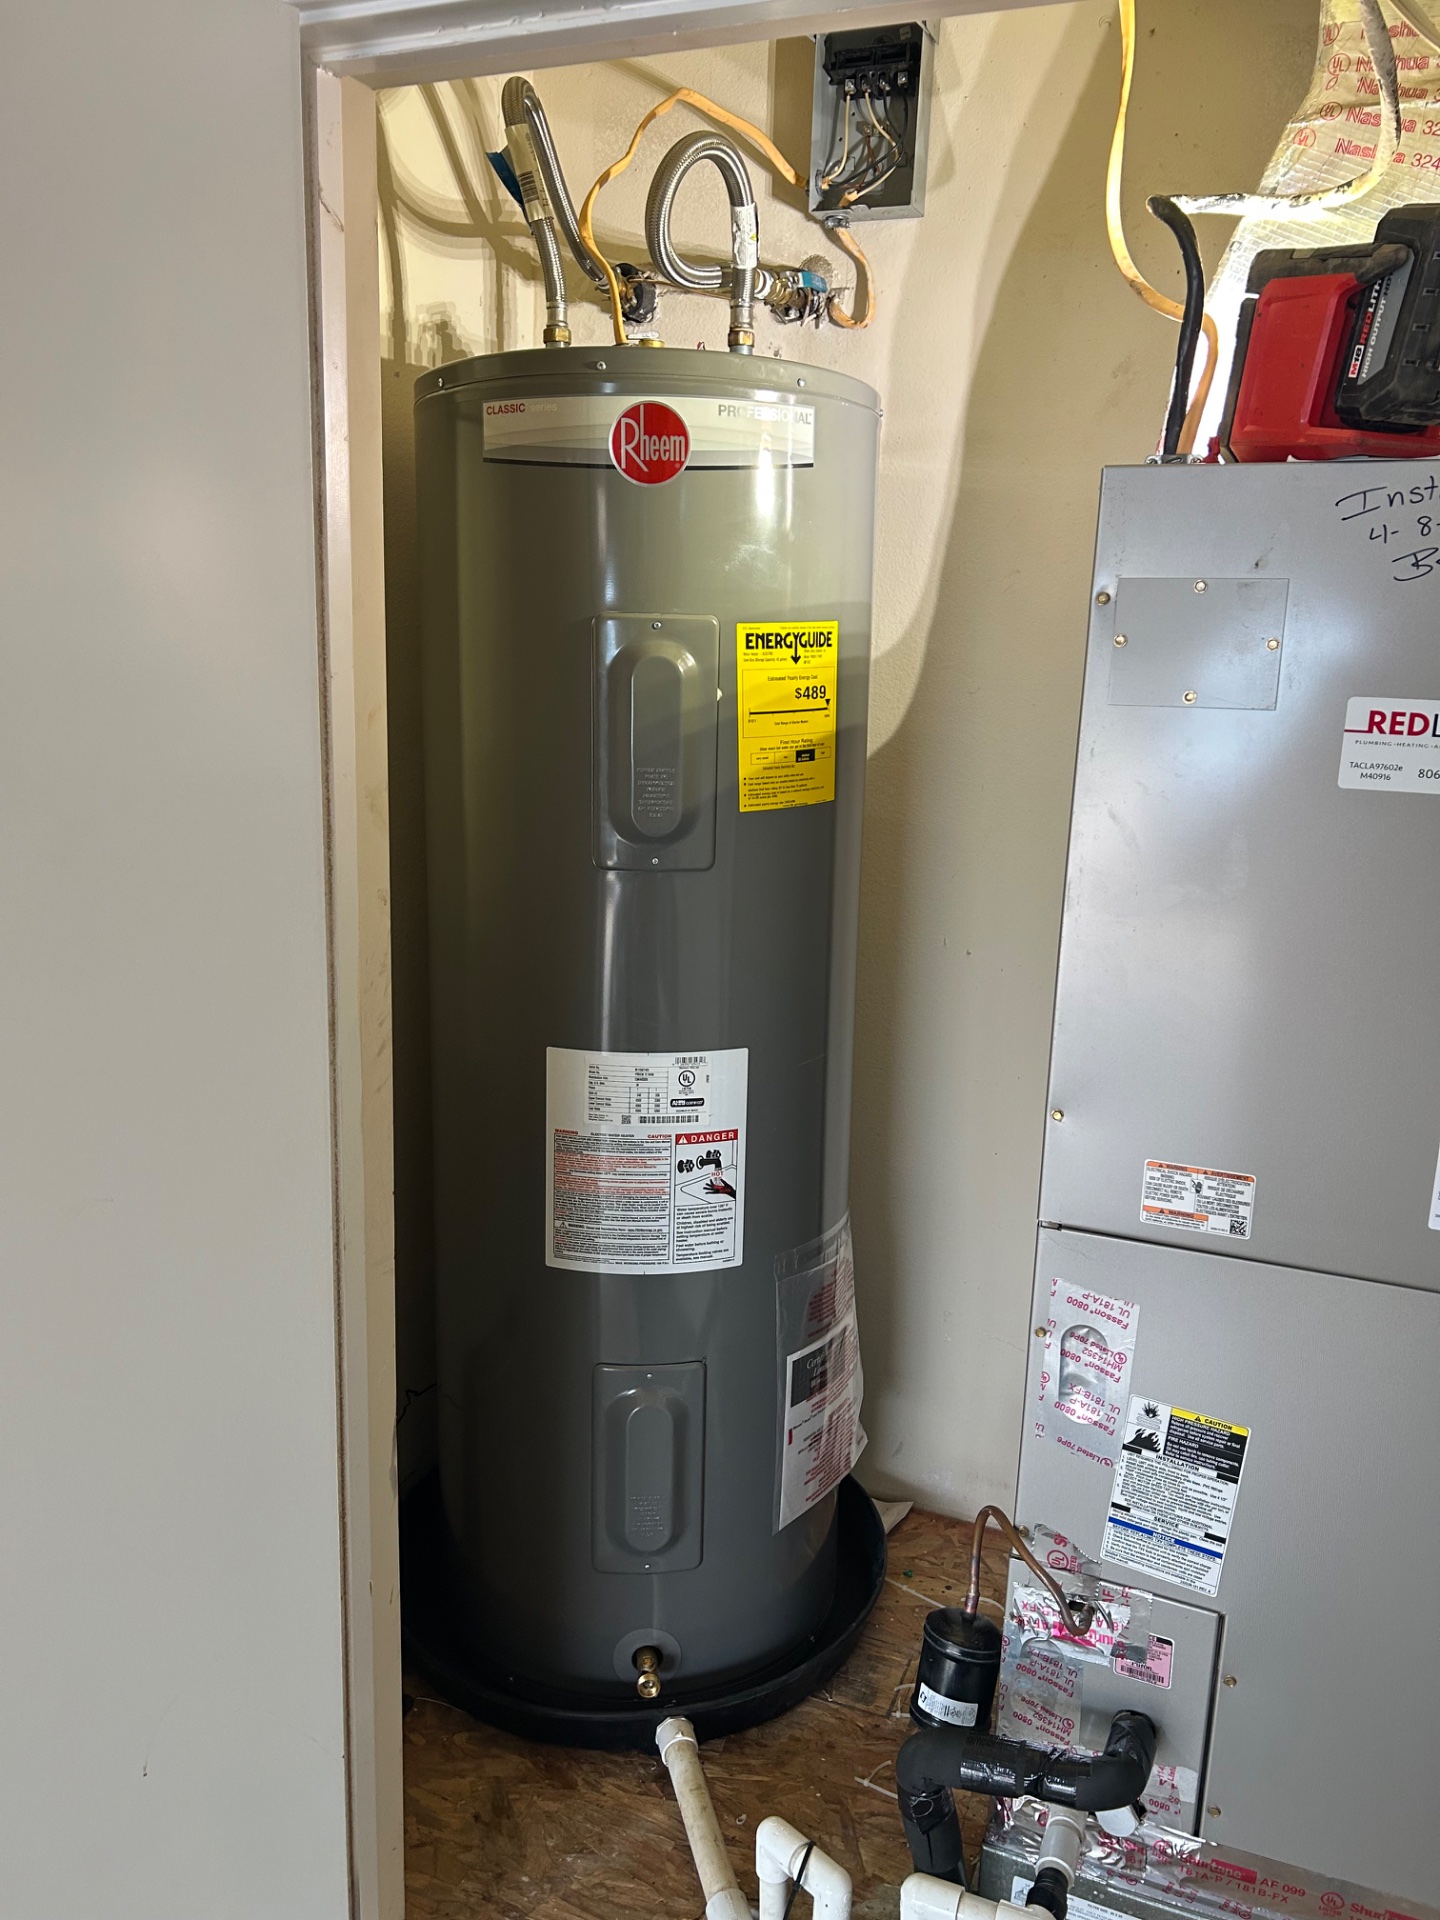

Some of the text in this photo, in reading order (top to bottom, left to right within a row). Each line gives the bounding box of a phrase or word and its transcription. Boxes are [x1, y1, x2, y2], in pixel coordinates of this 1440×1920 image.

[1356, 55, 1429, 73] Nahua
[1357, 77, 1428, 99] Nahua
[1411, 153, 1440, 170] 324
[1360, 279, 1382, 344] REDLITH
[1361, 348, 1374, 378] HIGH
[1370, 297, 1386, 346] OUTPUT
[1349, 346, 1363, 376] M18
[486, 402, 558, 416] CLASSIC series
[620, 404, 685, 472] Rheem
[1334, 475, 1440, 521] Inst
[745, 631, 833, 650] ENERGYGUIDE
[794, 685, 826, 700] $489
[1368, 710, 1440, 737] REDL
[1349, 762, 1403, 772] TACLA97602e
[1418, 768, 1440, 780] 806
[1360, 772, 1391, 781] M40916
[691, 1131, 734, 1143] DANGER
[1168, 1208, 1194, 1219] WARNING
[1066, 1296, 1090, 1312] 0800
[1082, 1292, 1130, 1319] UL 181A-P
[1069, 1331, 1089, 1345] 70P6
[1060, 1349, 1081, 1363] 0800
[1090, 1341, 1114, 1358] Listed
[1082, 1346, 1123, 1373] MH14352
[1069, 1383, 1121, 1415] UL 181B-FX
[1054, 1401, 1076, 1416] 0800
[1069, 1398, 1116, 1425] UL 181A-P
[1184, 1418, 1209, 1430] PRESSURE
[1209, 1426, 1231, 1436] HAZARD
[1203, 1418, 1233, 1431] CAUTION
[1057, 1436, 1101, 1465] Listed 70P6
[1167, 1435, 1199, 1449] FIRE HAZARD
[1155, 1453, 1199, 1472] INSTALLATION
[1153, 1515, 1179, 1528] SERVICE
[1152, 1531, 1175, 1543] NOTICE
[1016, 1663, 1037, 1677] 0800
[1027, 1645, 1078, 1678] UL 181B-FX
[1029, 1659, 1075, 1688] UL 181A-P
[1013, 1711, 1032, 1726] 0800
[1033, 1711, 1072, 1736] MH14352
[1149, 1798, 1170, 1812] 0800
[1179, 1866, 1223, 1883] 181A-P
[1236, 1882, 1288, 1903] 181B-FX
[1260, 1878, 1279, 1888] AF
[1282, 1884, 1306, 1897] 099
